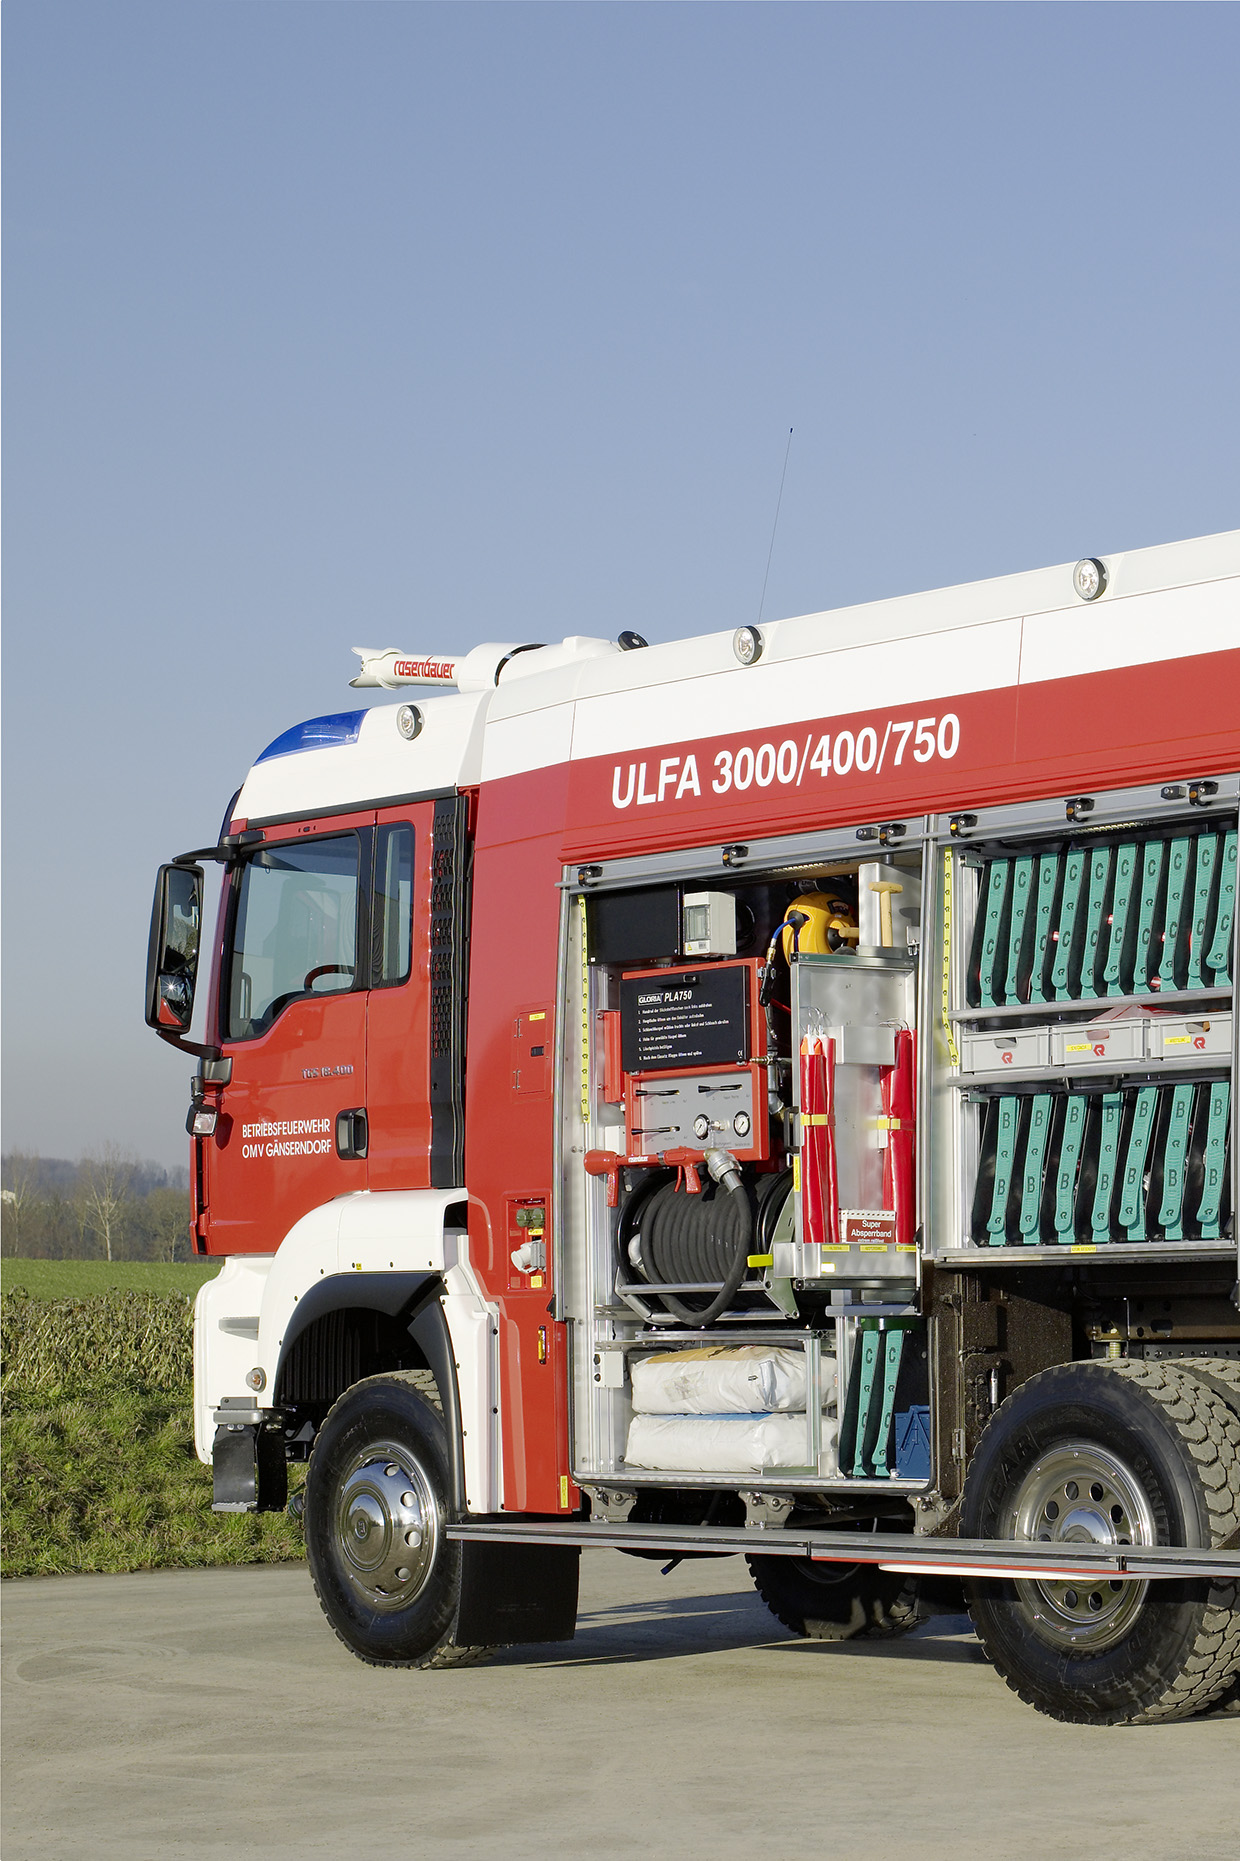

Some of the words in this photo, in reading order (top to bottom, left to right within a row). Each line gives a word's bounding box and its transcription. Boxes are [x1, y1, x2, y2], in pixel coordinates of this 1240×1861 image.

[394, 656, 455, 679] rosenbauer
[612, 754, 701, 809] ULFA
[712, 713, 960, 794] 3000/400/750
[639, 995, 661, 1004] GLORIA
[664, 990, 693, 1002] PLA750
[302, 1068, 319, 1079] TGS
[321, 1065, 354, 1077] 18.400
[242, 1118, 331, 1138] BETRIEBSFEUERWEHR
[242, 1144, 265, 1158] OMV
[265, 1139, 332, 1157] GÄNSERNDORF
[862, 1219, 881, 1229] Super
[851, 1229, 892, 1238] Absperrband
